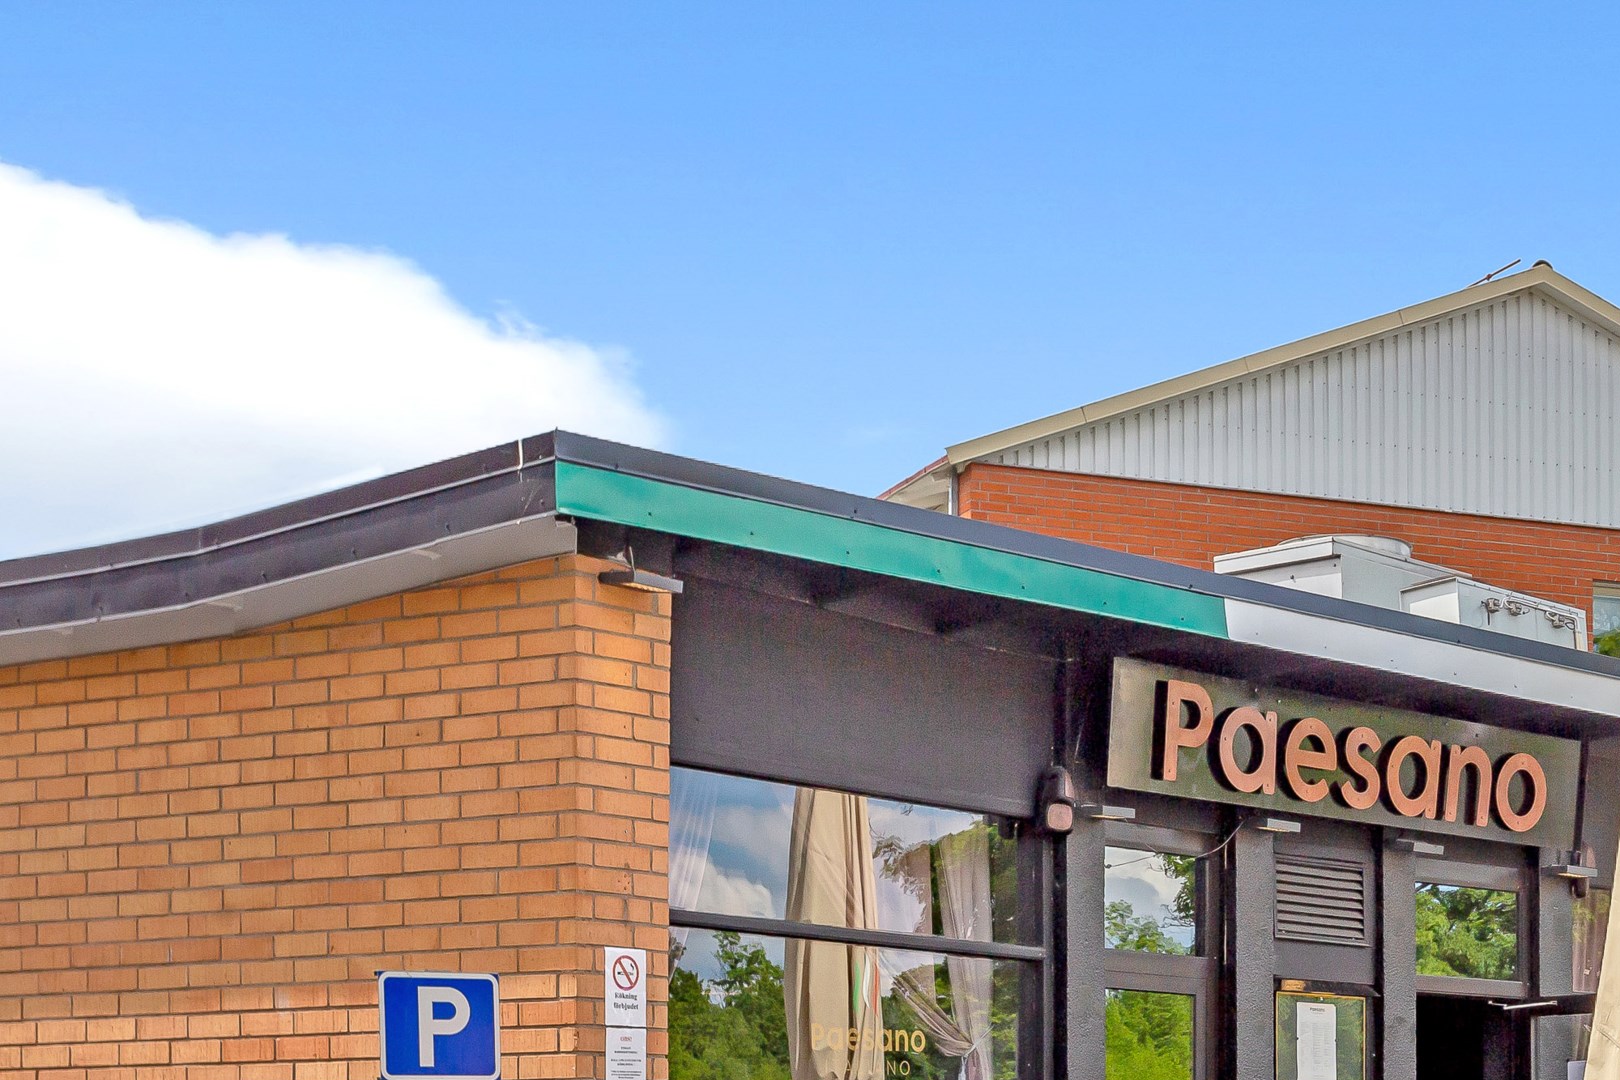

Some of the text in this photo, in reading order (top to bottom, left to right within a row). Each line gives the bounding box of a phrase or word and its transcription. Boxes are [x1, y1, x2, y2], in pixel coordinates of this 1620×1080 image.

[1161, 678, 1548, 833] Paesano
[417, 985, 471, 1068] P
[810, 1022, 926, 1053] Paesano
